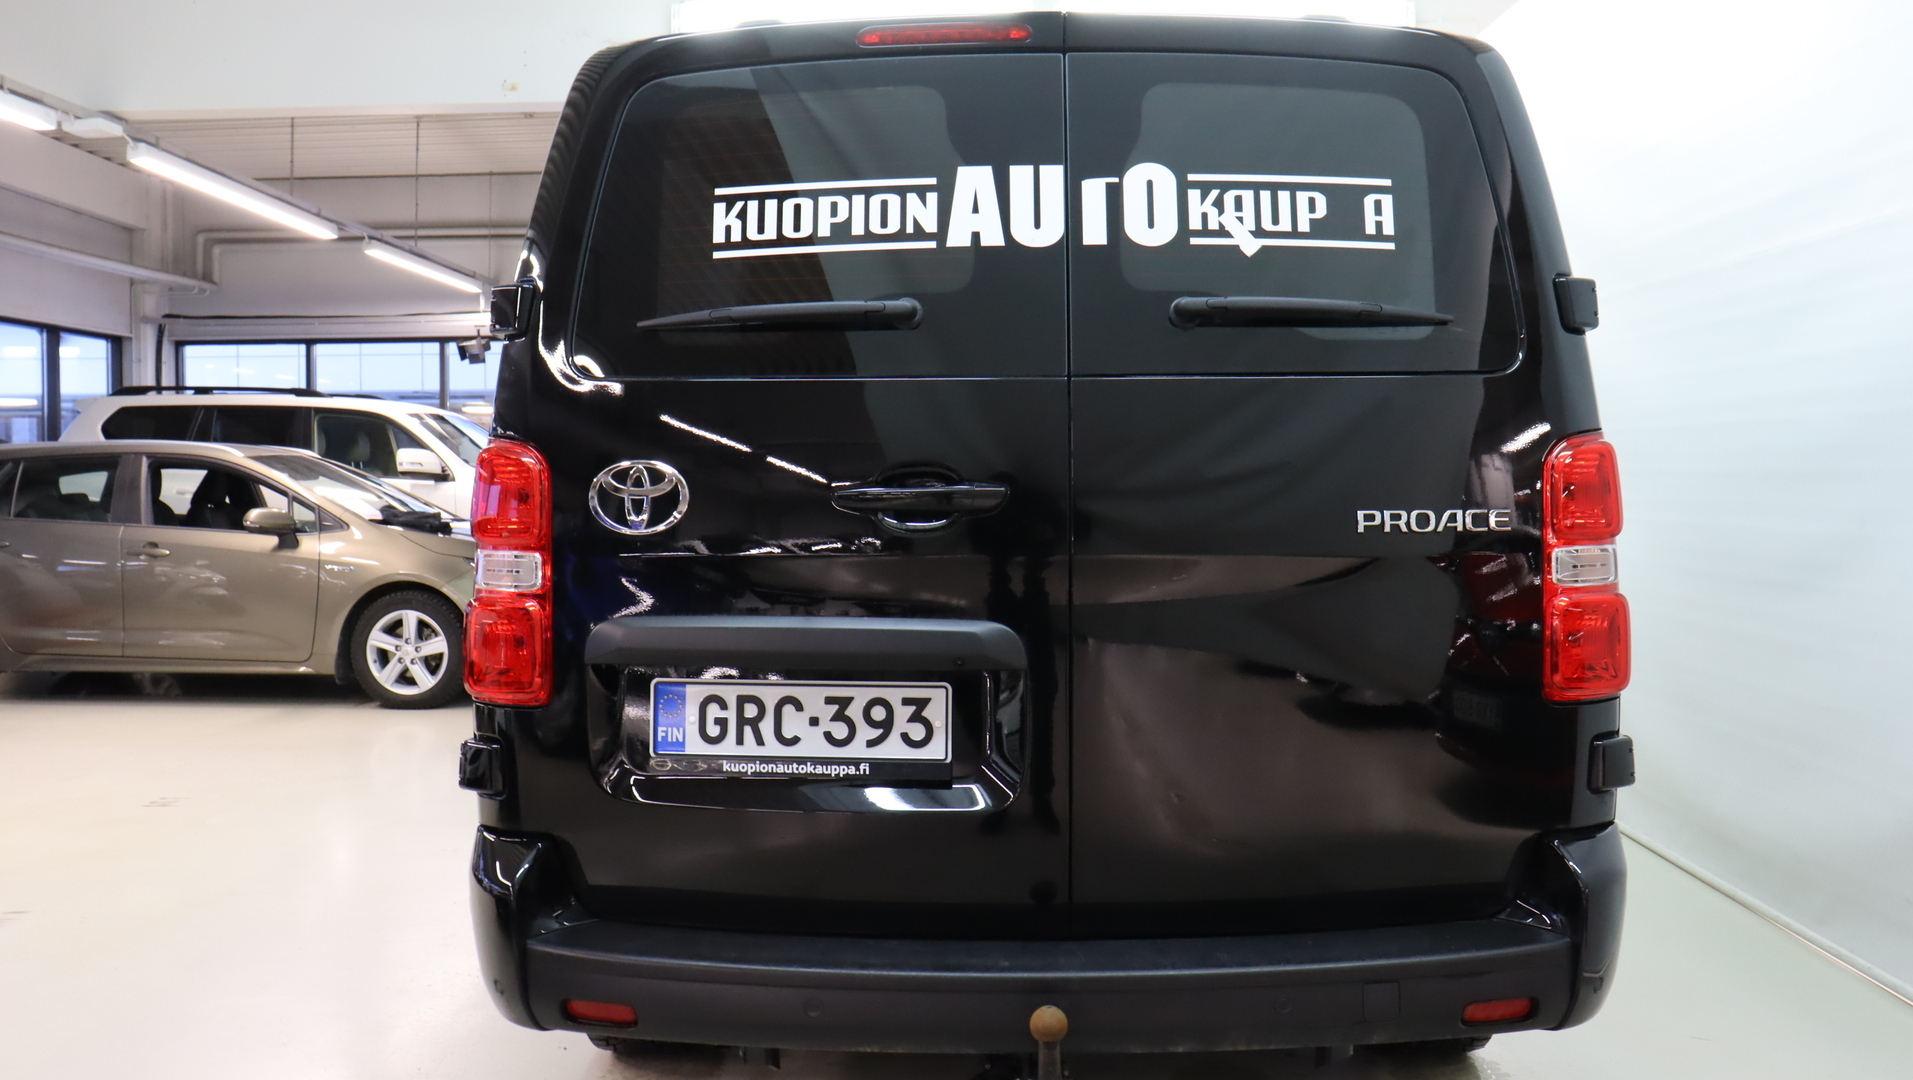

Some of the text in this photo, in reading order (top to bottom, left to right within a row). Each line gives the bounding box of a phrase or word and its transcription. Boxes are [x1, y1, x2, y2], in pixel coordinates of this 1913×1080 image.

[712, 192, 937, 243] KUOPION
[1187, 188, 1395, 236] KAUPA
[1357, 509, 1512, 533] PROACE
[657, 726, 684, 743] FIN
[722, 760, 870, 777] kuopionautokauppa.fi
